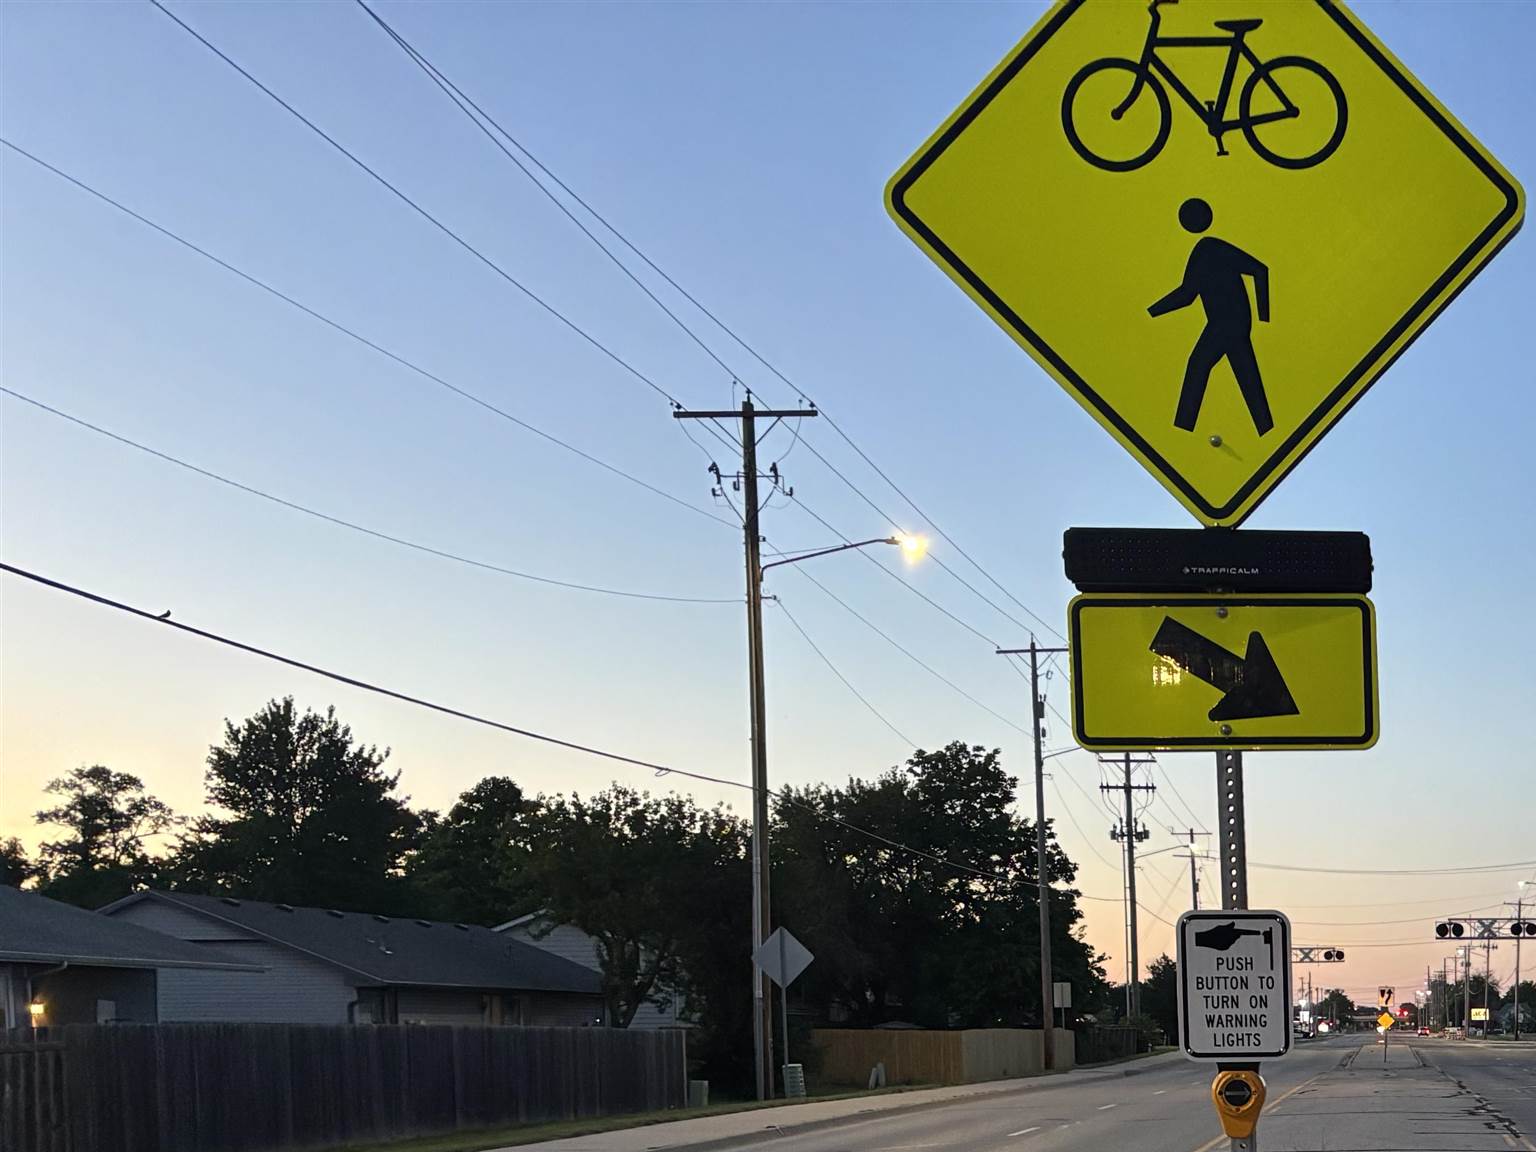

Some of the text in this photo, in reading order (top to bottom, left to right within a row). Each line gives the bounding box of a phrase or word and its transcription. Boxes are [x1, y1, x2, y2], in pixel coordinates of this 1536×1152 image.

[1216, 957, 1254, 971] PUSH
[1196, 976, 1275, 990] BUTTON TO
[1203, 995, 1268, 1009] TURN ON
[1205, 1014, 1268, 1028] WARNING
[1213, 1033, 1262, 1047] LIGHTS
